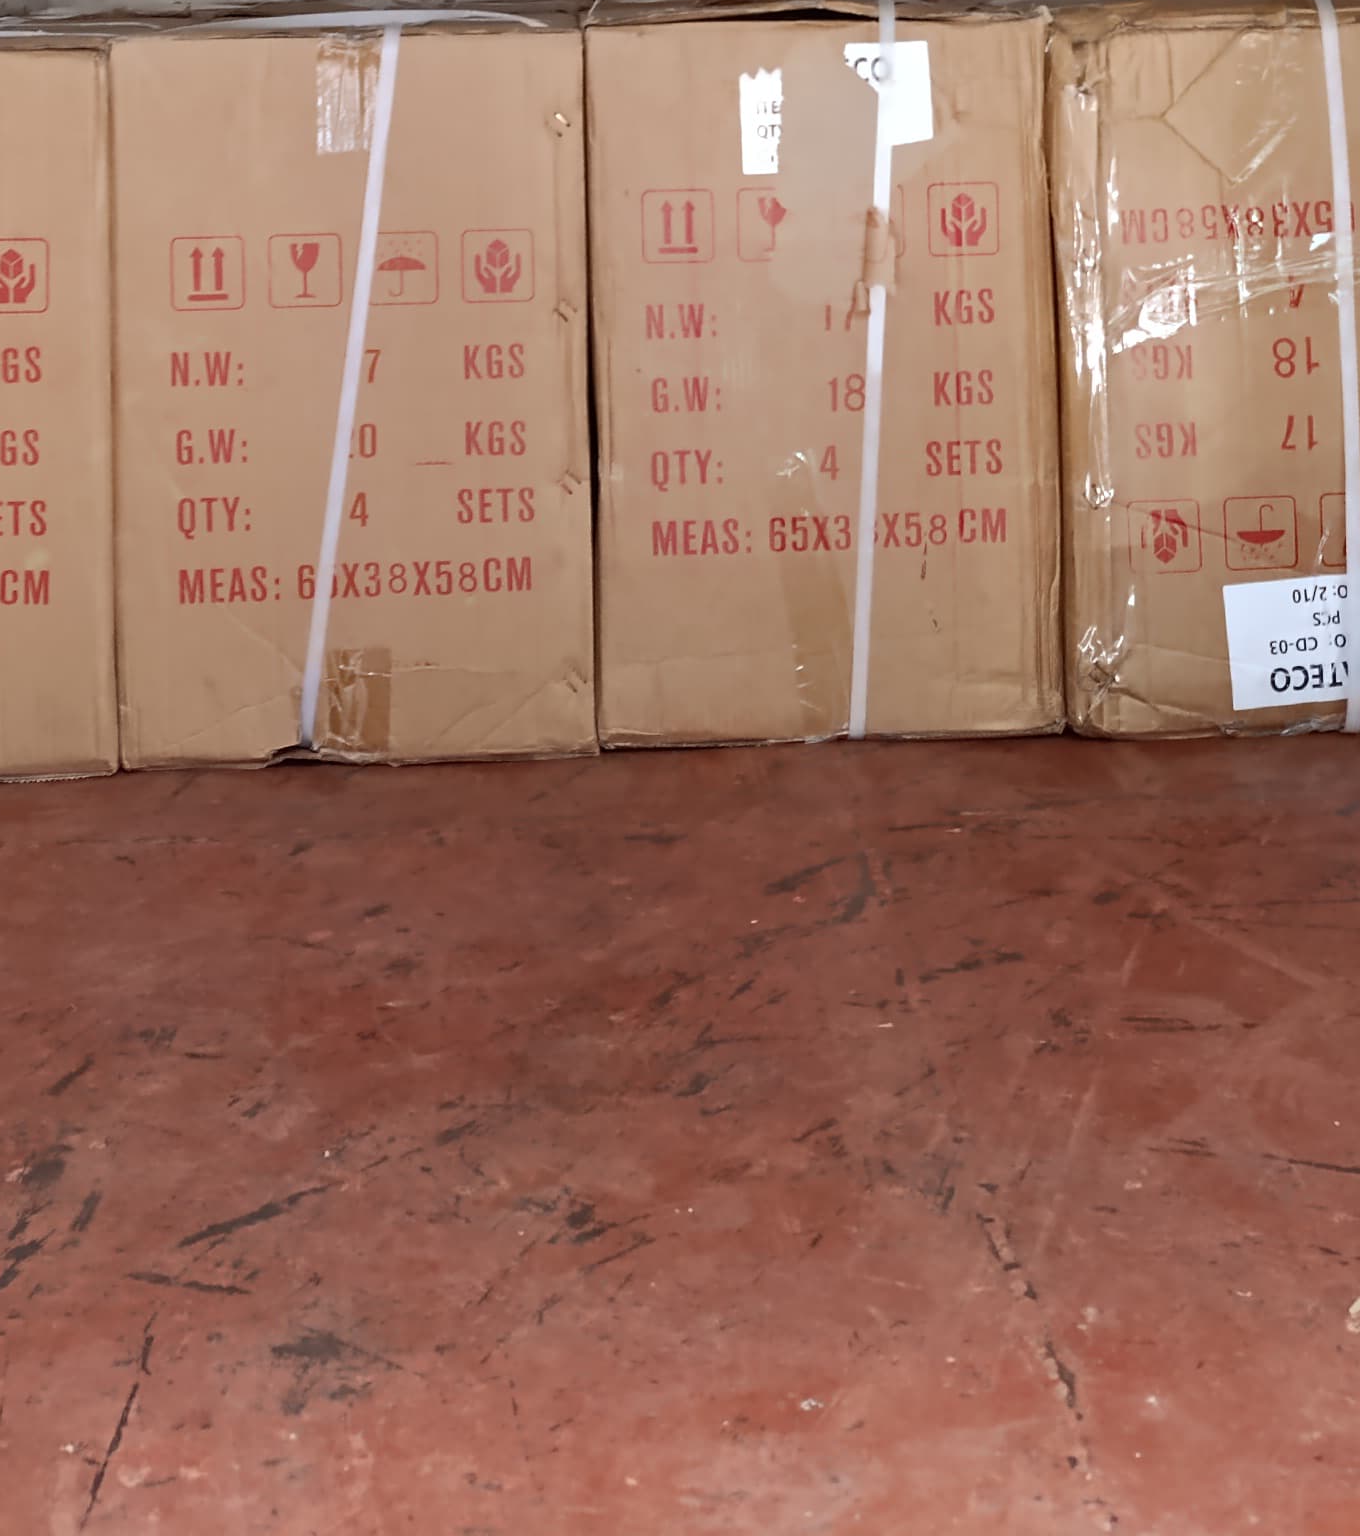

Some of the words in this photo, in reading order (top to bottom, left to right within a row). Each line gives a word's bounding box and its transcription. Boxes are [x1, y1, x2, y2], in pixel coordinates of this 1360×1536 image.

[1121, 200, 1356, 242] 5X38X58CM
[647, 304, 719, 339] N.W:
[934, 288, 995, 327] KGS
[171, 352, 243, 386] N.W:
[464, 342, 524, 379] KGS
[1132, 344, 1193, 383] KGS
[1272, 336, 1319, 378] 18
[652, 376, 723, 413] G.W:
[828, 373, 865, 412] 18
[934, 370, 993, 406] KGS
[176, 429, 247, 465] G.W:
[465, 421, 525, 456] KGS
[1137, 422, 1197, 458] KGS
[1280, 416, 1316, 450] 17
[651, 449, 723, 492] QTY:
[820, 443, 838, 480] 4
[926, 439, 1002, 477] SETS
[177, 496, 251, 540] QTY:
[350, 492, 368, 528] 4
[457, 487, 534, 524] SETS
[652, 519, 753, 556] MEAS:
[769, 508, 1007, 552] 65X3X58CM
[179, 566, 280, 604] MEAS:
[1292, 585, 1327, 604] 2/10
[1269, 636, 1318, 655] CD-03
